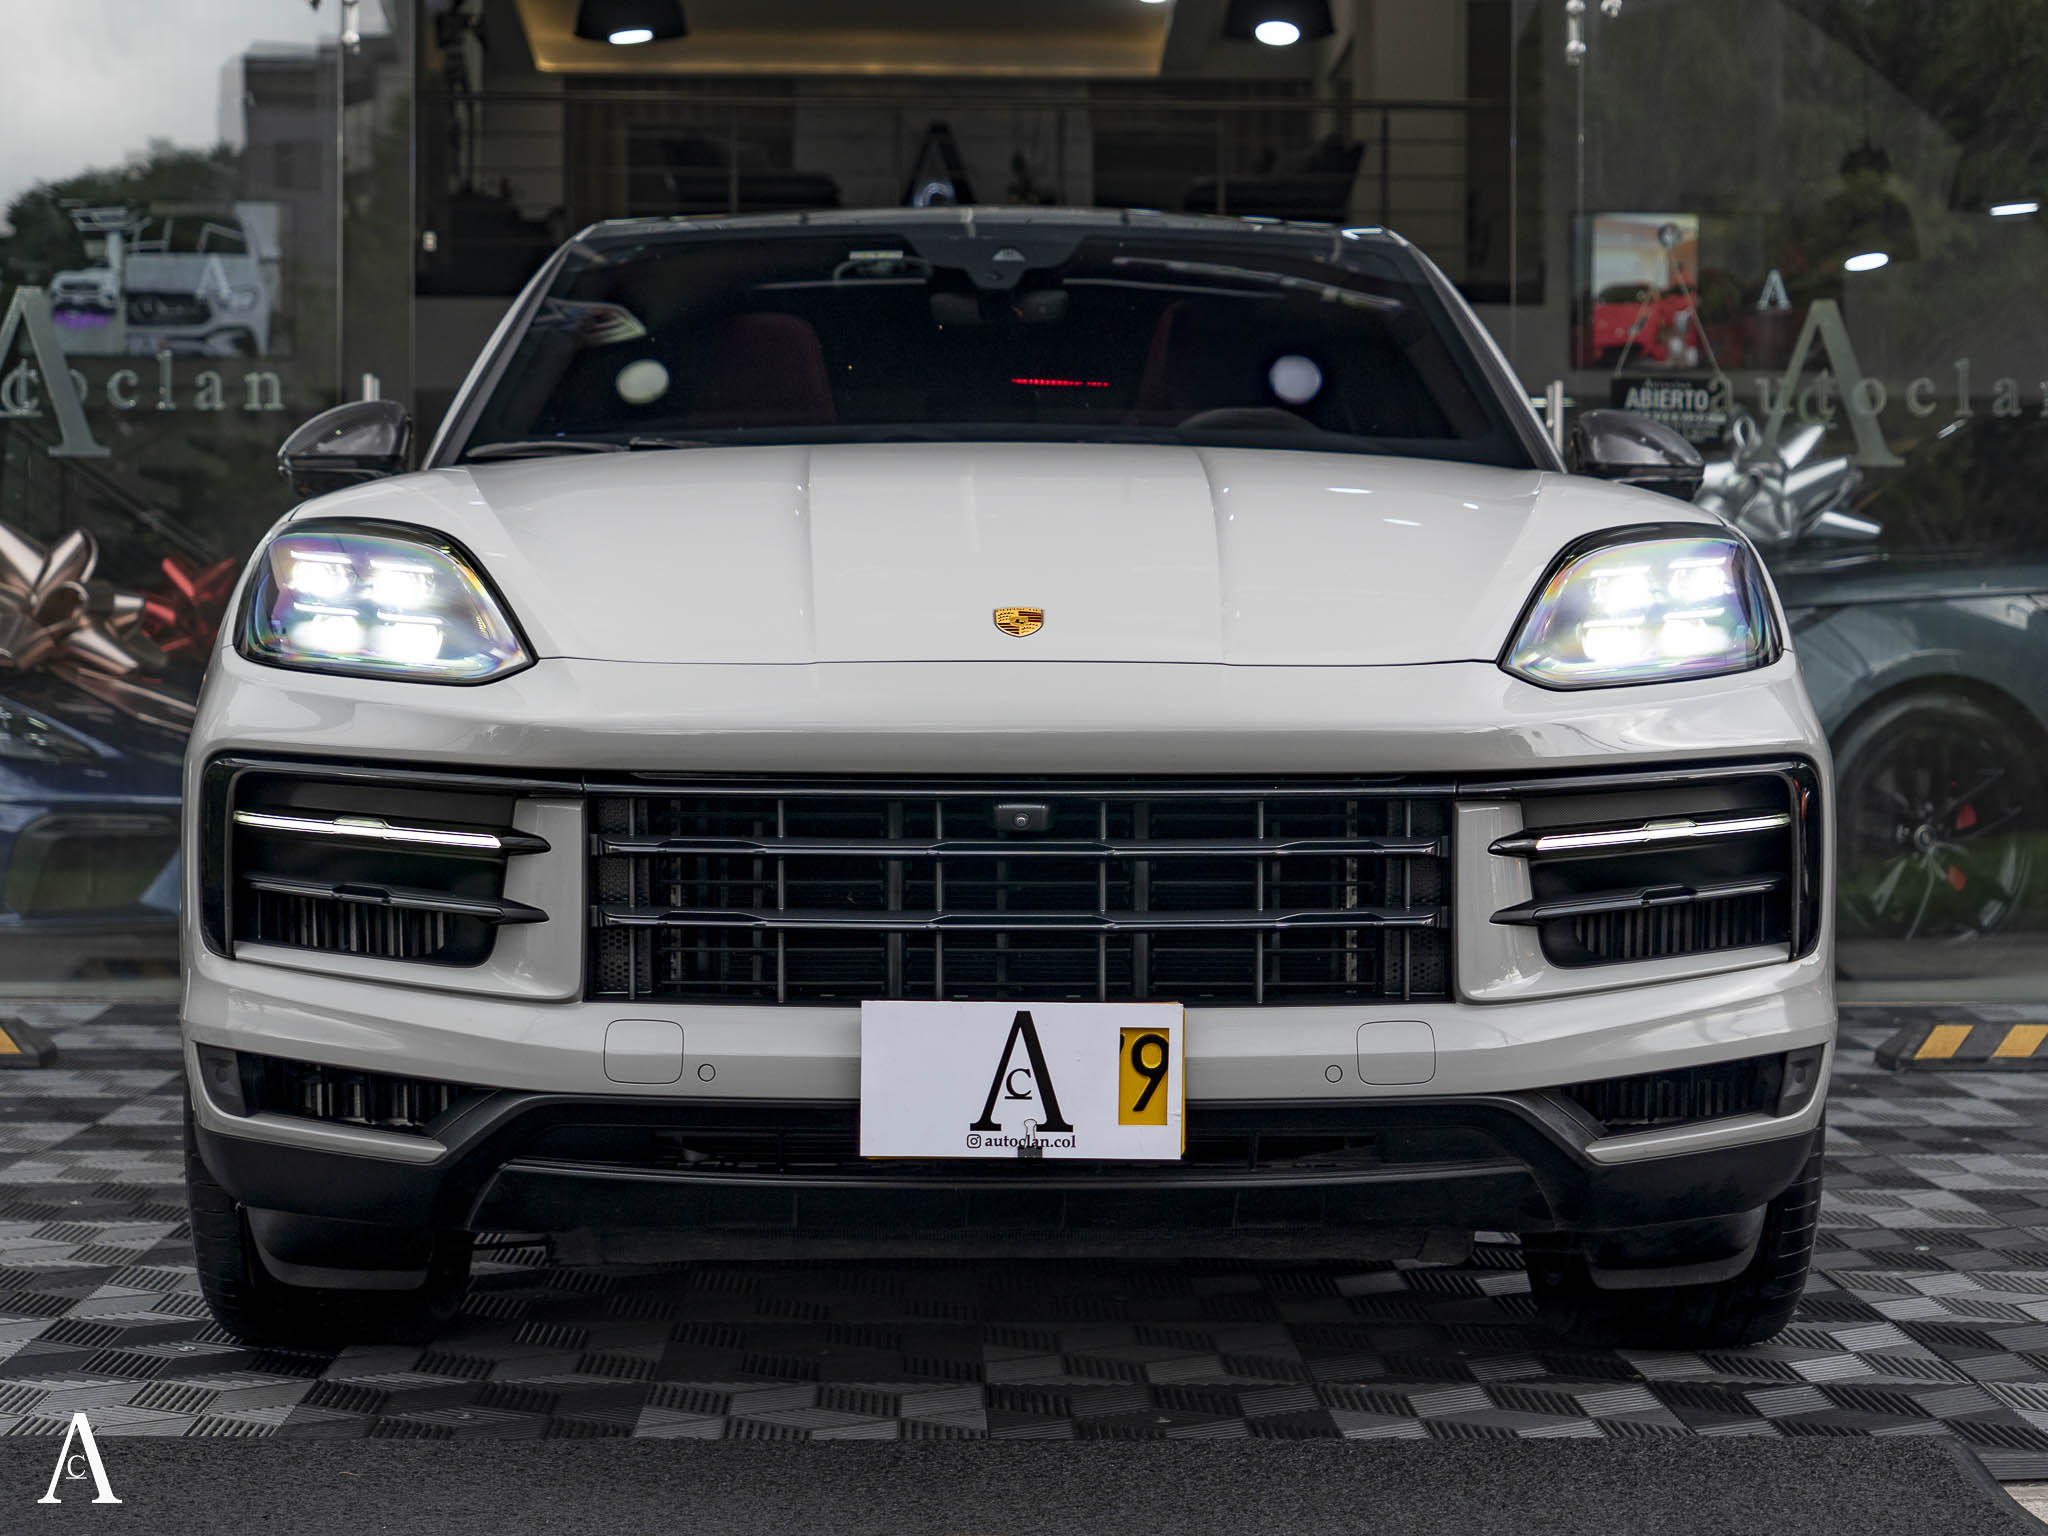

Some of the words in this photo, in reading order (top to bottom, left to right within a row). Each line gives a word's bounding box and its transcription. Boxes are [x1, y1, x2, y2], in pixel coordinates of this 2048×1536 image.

[1624, 386, 1709, 411] ABIERTO
[1707, 357, 2048, 417] autocla
[1762, 298, 1905, 466] A
[970, 1010, 1074, 1132] A
[1120, 1032, 1169, 1112] 9
[984, 1134, 1077, 1148] autoclan.col
